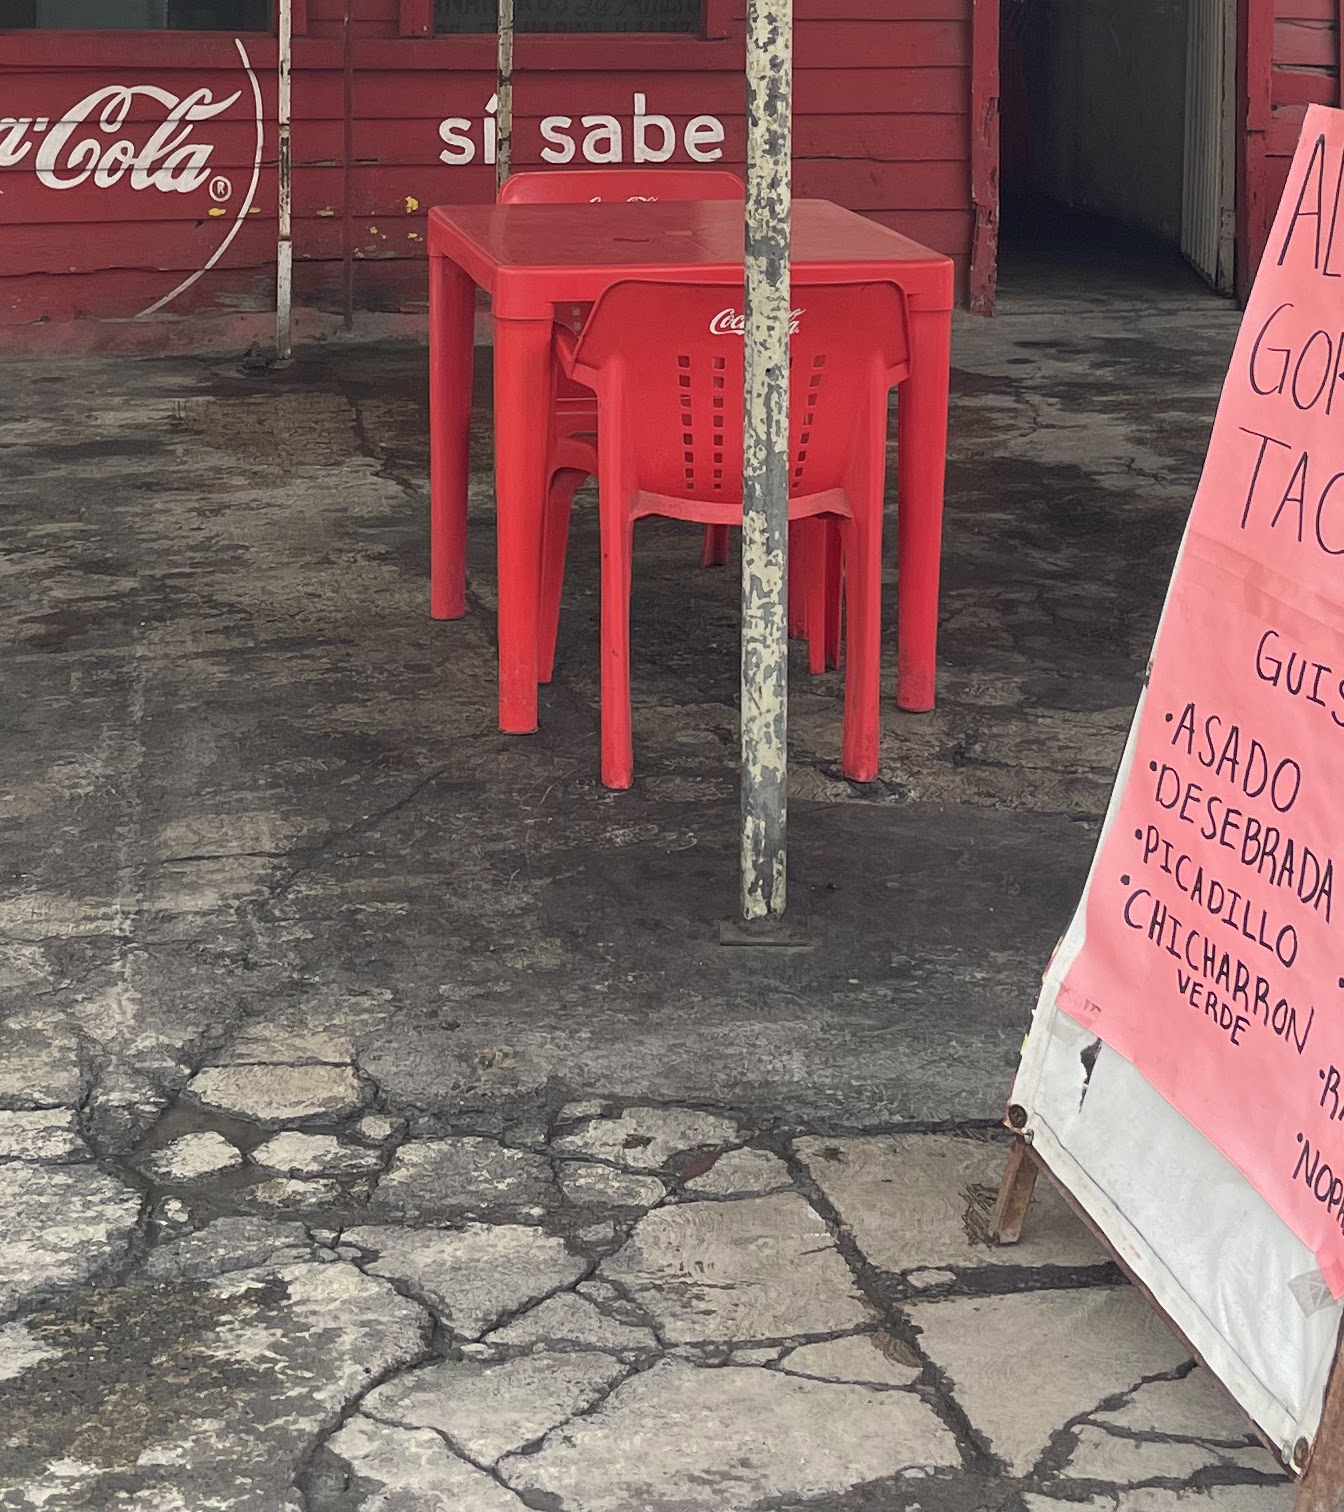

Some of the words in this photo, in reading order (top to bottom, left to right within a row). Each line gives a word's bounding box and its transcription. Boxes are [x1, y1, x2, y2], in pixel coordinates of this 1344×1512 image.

[439, 93, 497, 165] sí
[539, 93, 726, 164] sabe
[1171, 702, 1301, 813] ASADO
[1143, 825, 1299, 968] PICADILLO
[1155, 764, 1334, 923] DESEBRADA
[1124, 889, 1316, 1055] CHICHARRON
[1177, 969, 1252, 1047] VERDE
